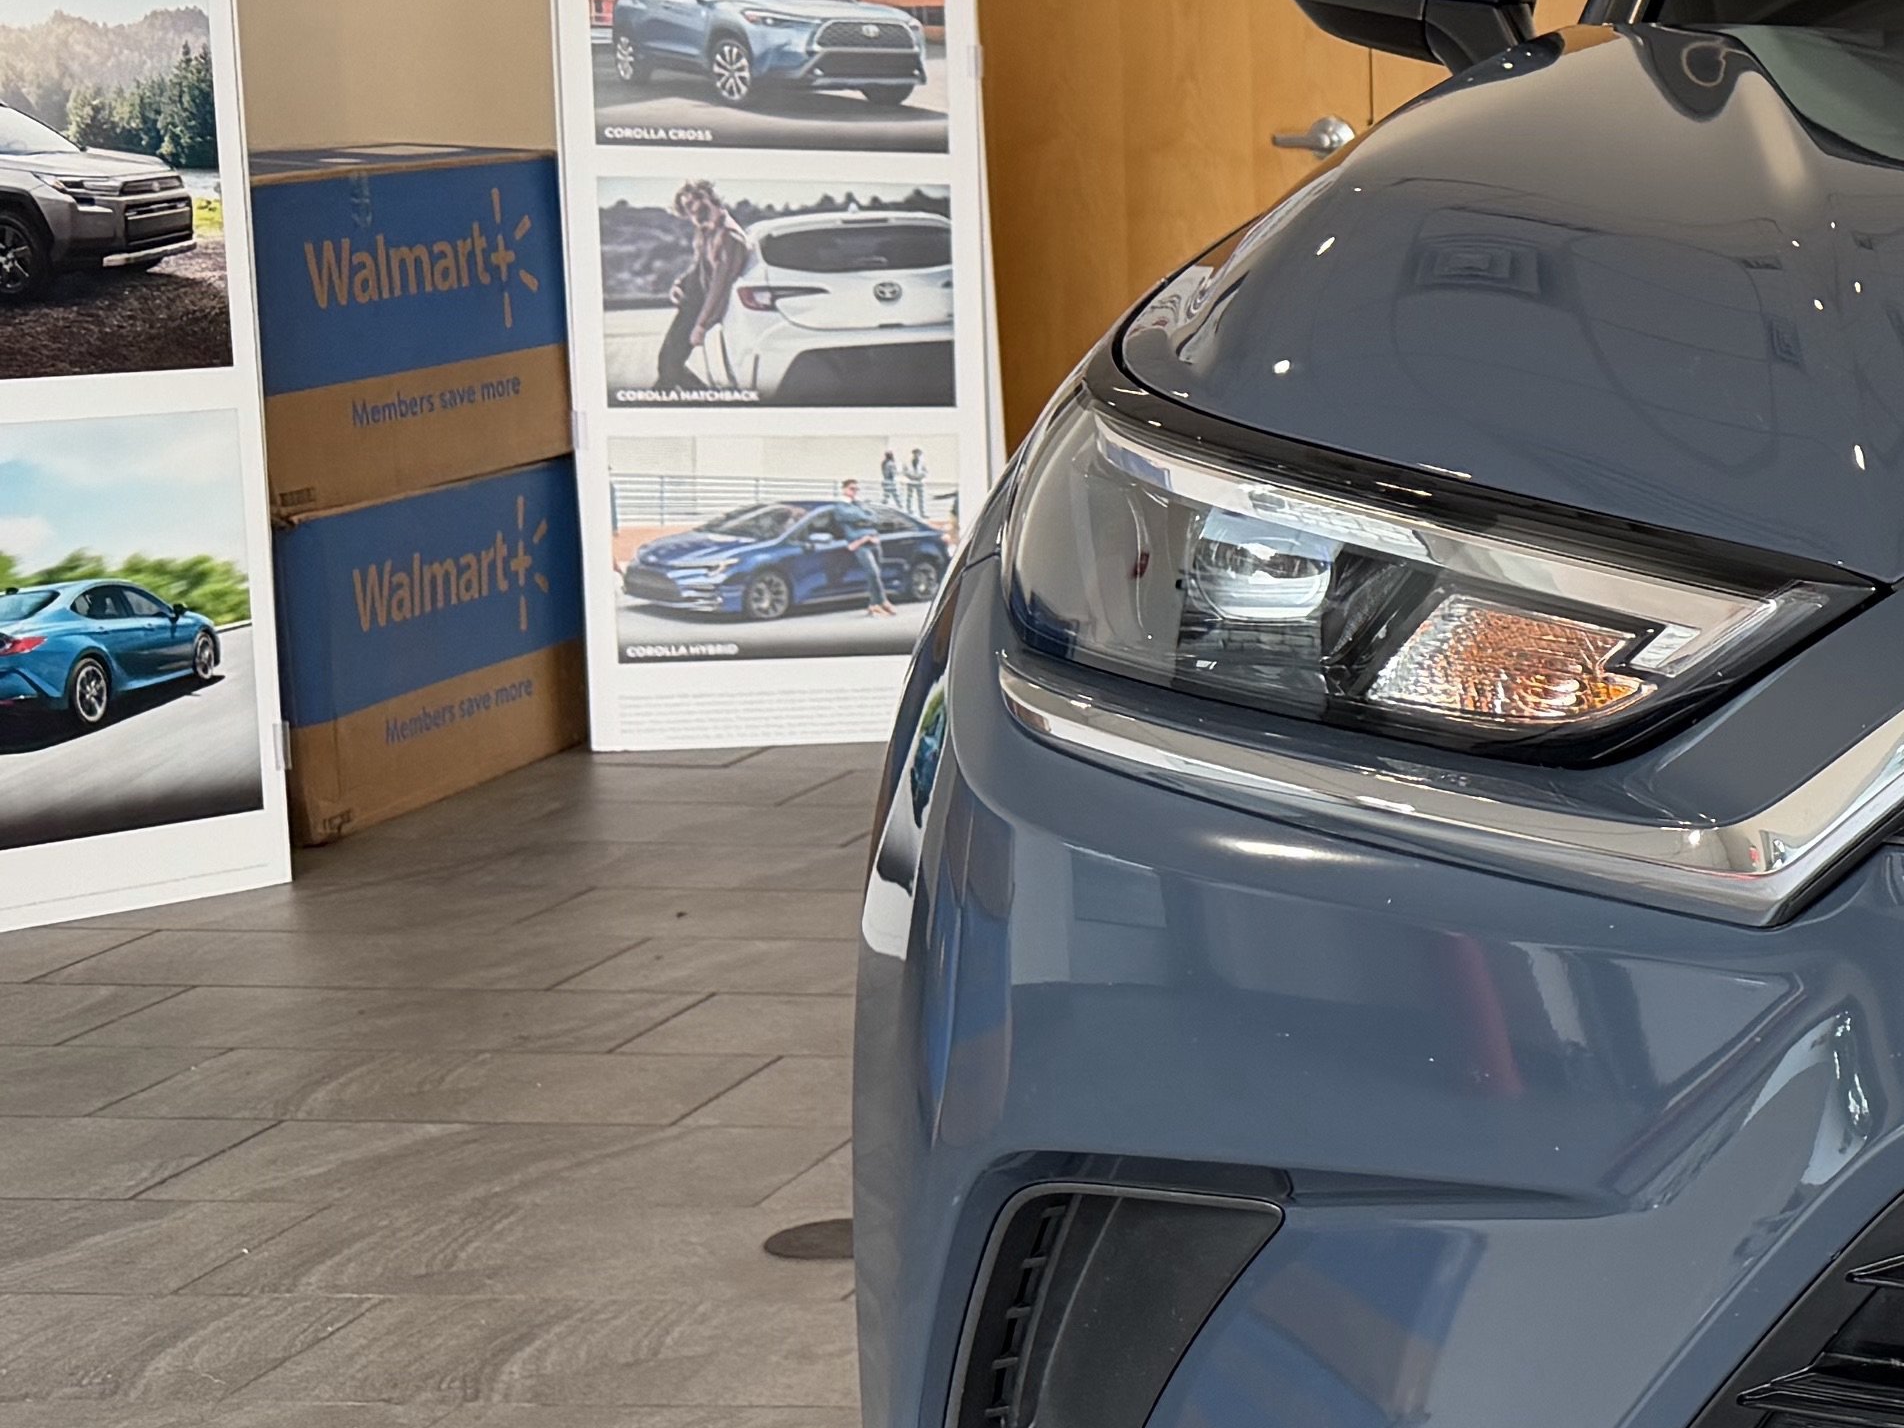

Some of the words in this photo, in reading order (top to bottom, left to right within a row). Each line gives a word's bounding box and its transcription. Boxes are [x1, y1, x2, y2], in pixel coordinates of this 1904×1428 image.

[604, 127, 667, 139] COROLLA
[668, 128, 713, 141] CROSS
[305, 221, 490, 309] Walmart
[352, 391, 435, 427] Members
[439, 385, 476, 409] save
[480, 376, 521, 402] more
[617, 390, 678, 402] COROLLA
[353, 531, 508, 634] Walmart
[386, 706, 455, 746] Members
[459, 692, 491, 719] save
[495, 678, 533, 706] more
